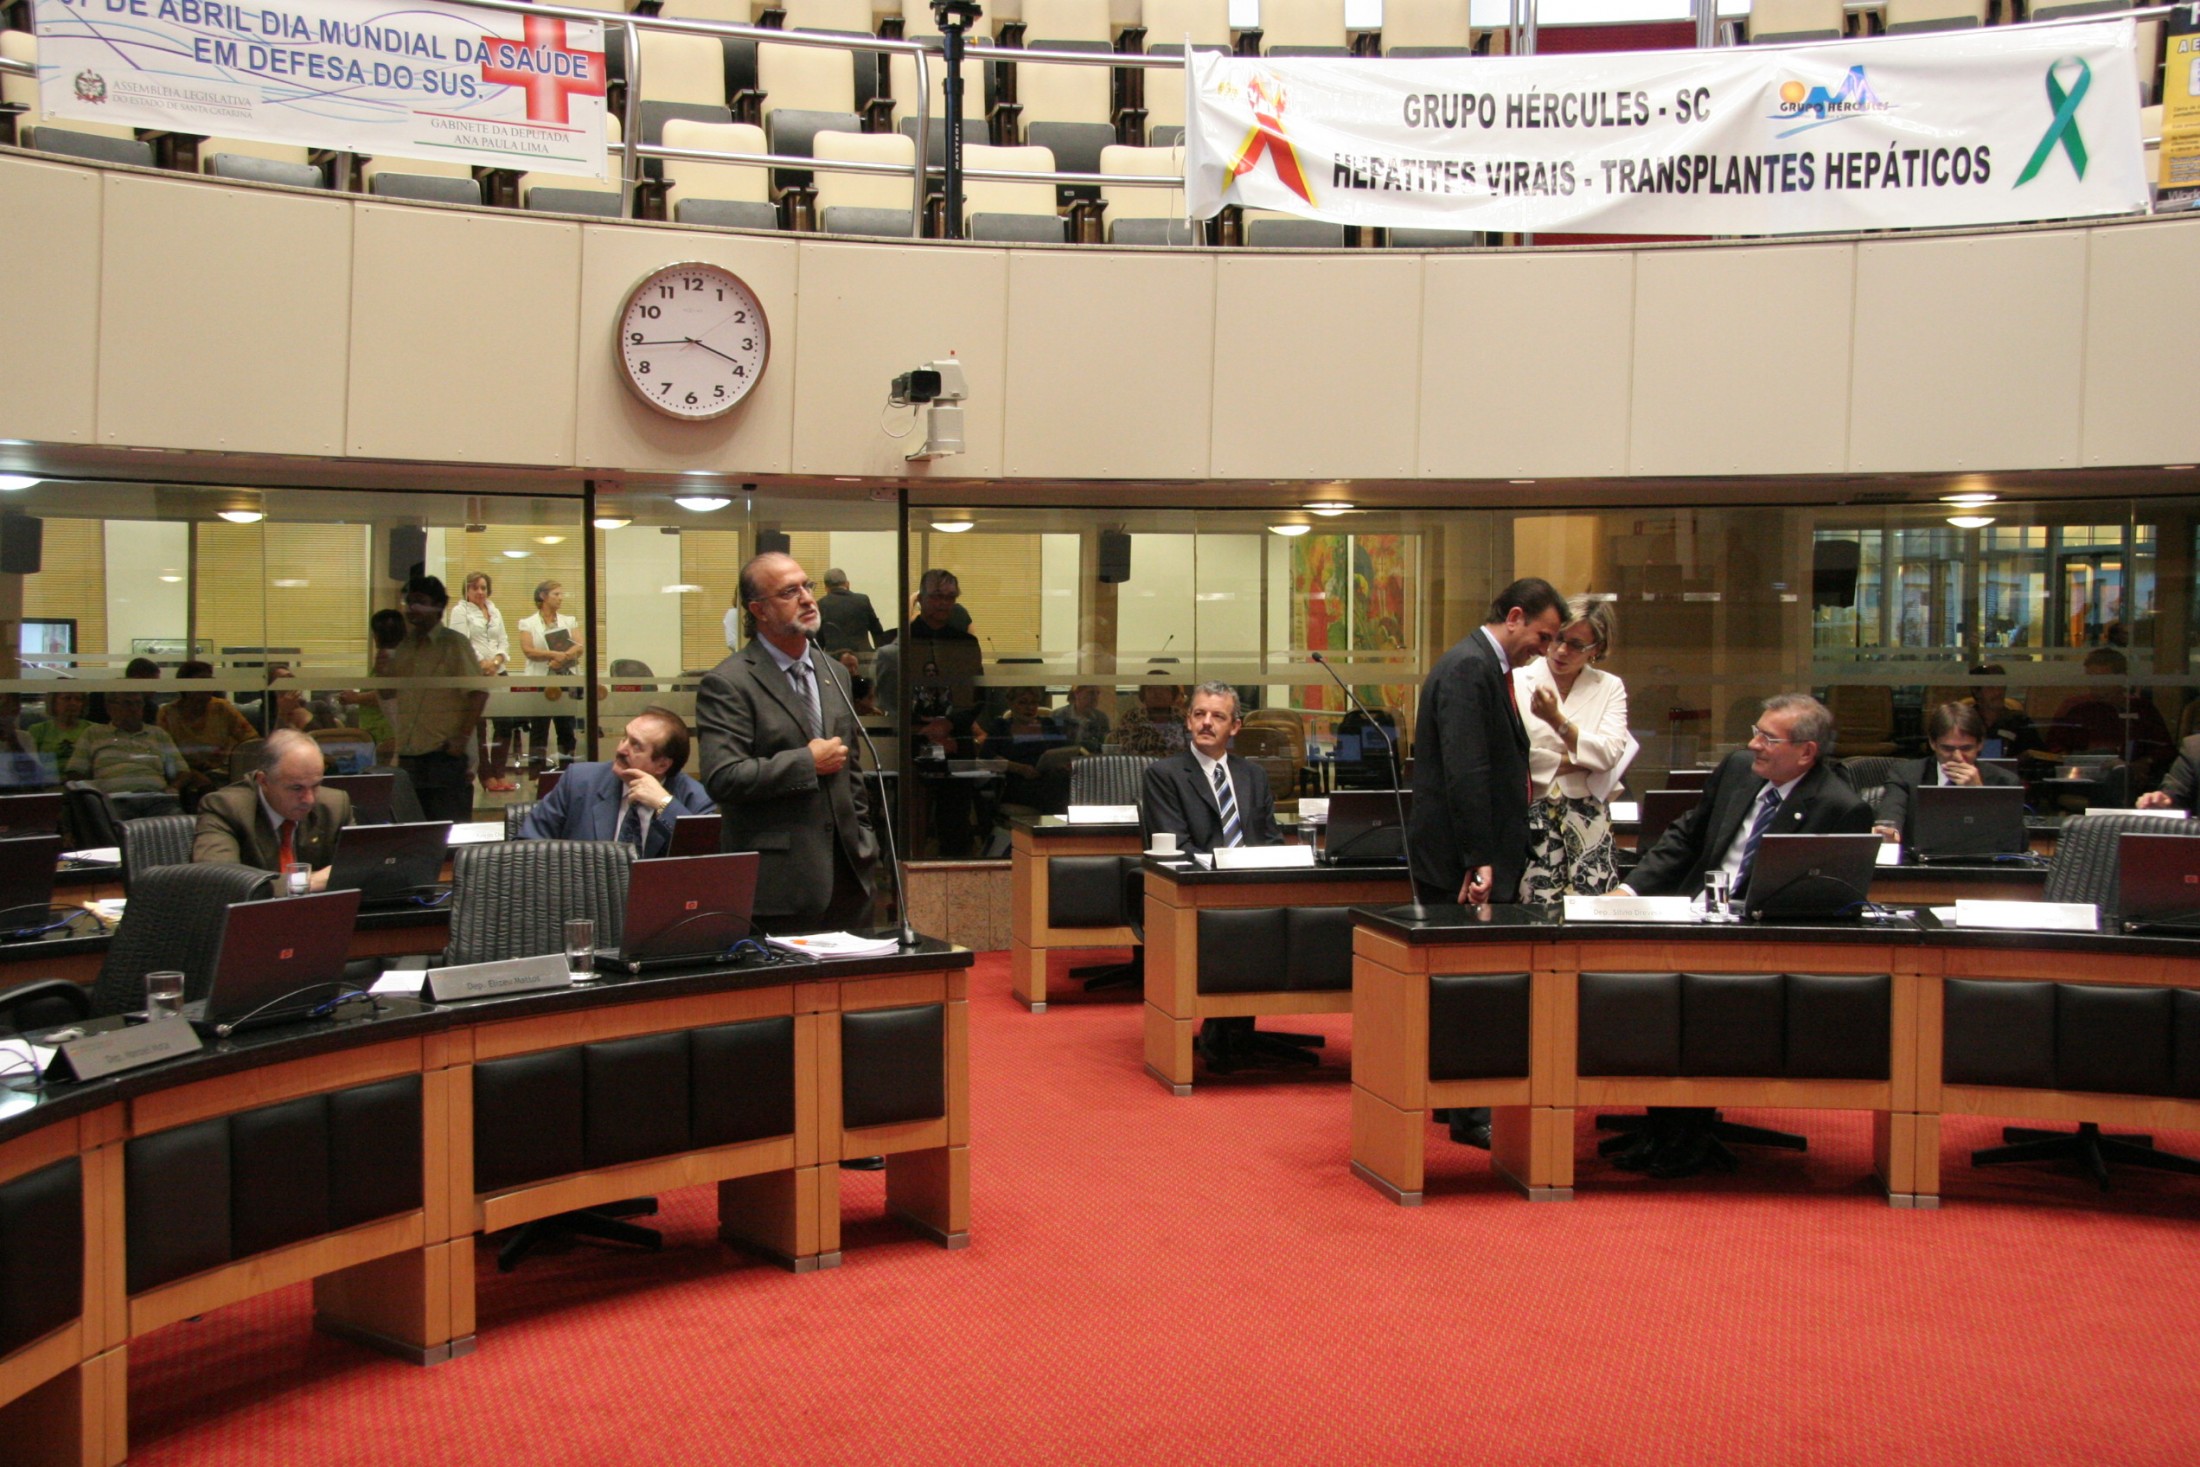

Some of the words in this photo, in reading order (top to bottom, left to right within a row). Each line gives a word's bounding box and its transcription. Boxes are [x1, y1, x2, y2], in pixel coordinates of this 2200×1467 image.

[158, 0, 252, 32] ABRIL
[261, 10, 311, 41] DIA
[319, 19, 446, 60] MUNDIAL
[455, 38, 492, 66] DA
[500, 45, 588, 79] SAÚDE
[194, 37, 238, 67] EM
[249, 45, 365, 84] DEFESA
[374, 62, 413, 89] DO
[422, 69, 483, 99] SUS.
[113, 80, 181, 99] ASSEMBLEIA
[184, 90, 252, 107] LEGISLATIVA
[112, 95, 128, 104] DO
[130, 97, 164, 108] ESTADO
[167, 102, 178, 110] DE
[180, 103, 208, 114] SANTA
[210, 108, 253, 119] CATARINA
[1403, 93, 1496, 129] GRUPO
[1506, 84, 1649, 129] HÉRCULES
[1658, 107, 1667, 116] -
[1675, 86, 1711, 125] SC
[1780, 102, 1824, 113] GRUPO
[431, 118, 489, 133] GABINETE
[492, 125, 508, 136] DA
[511, 127, 570, 143] DEPUTADA
[454, 135, 479, 146] ANA
[481, 137, 518, 150] PAULA
[521, 142, 549, 153] LIMA
[1333, 152, 1476, 194] HEPATITES
[1485, 160, 1576, 197] VIRAIS
[1583, 178, 1593, 187] -
[1600, 151, 1816, 195] TRANSPLANTES
[1825, 141, 1991, 191] HEPÁTICOS
[683, 277, 704, 292] 12
[659, 285, 675, 300] 11
[716, 288, 724, 302] 1
[639, 305, 661, 319] 10
[734, 310, 746, 324] 2
[630, 332, 644, 346] 9
[741, 338, 754, 351] 3
[638, 360, 651, 374] 8
[732, 365, 746, 378] 4
[660, 382, 673, 395] 7
[713, 385, 725, 398] 5
[685, 391, 698, 405] 6
